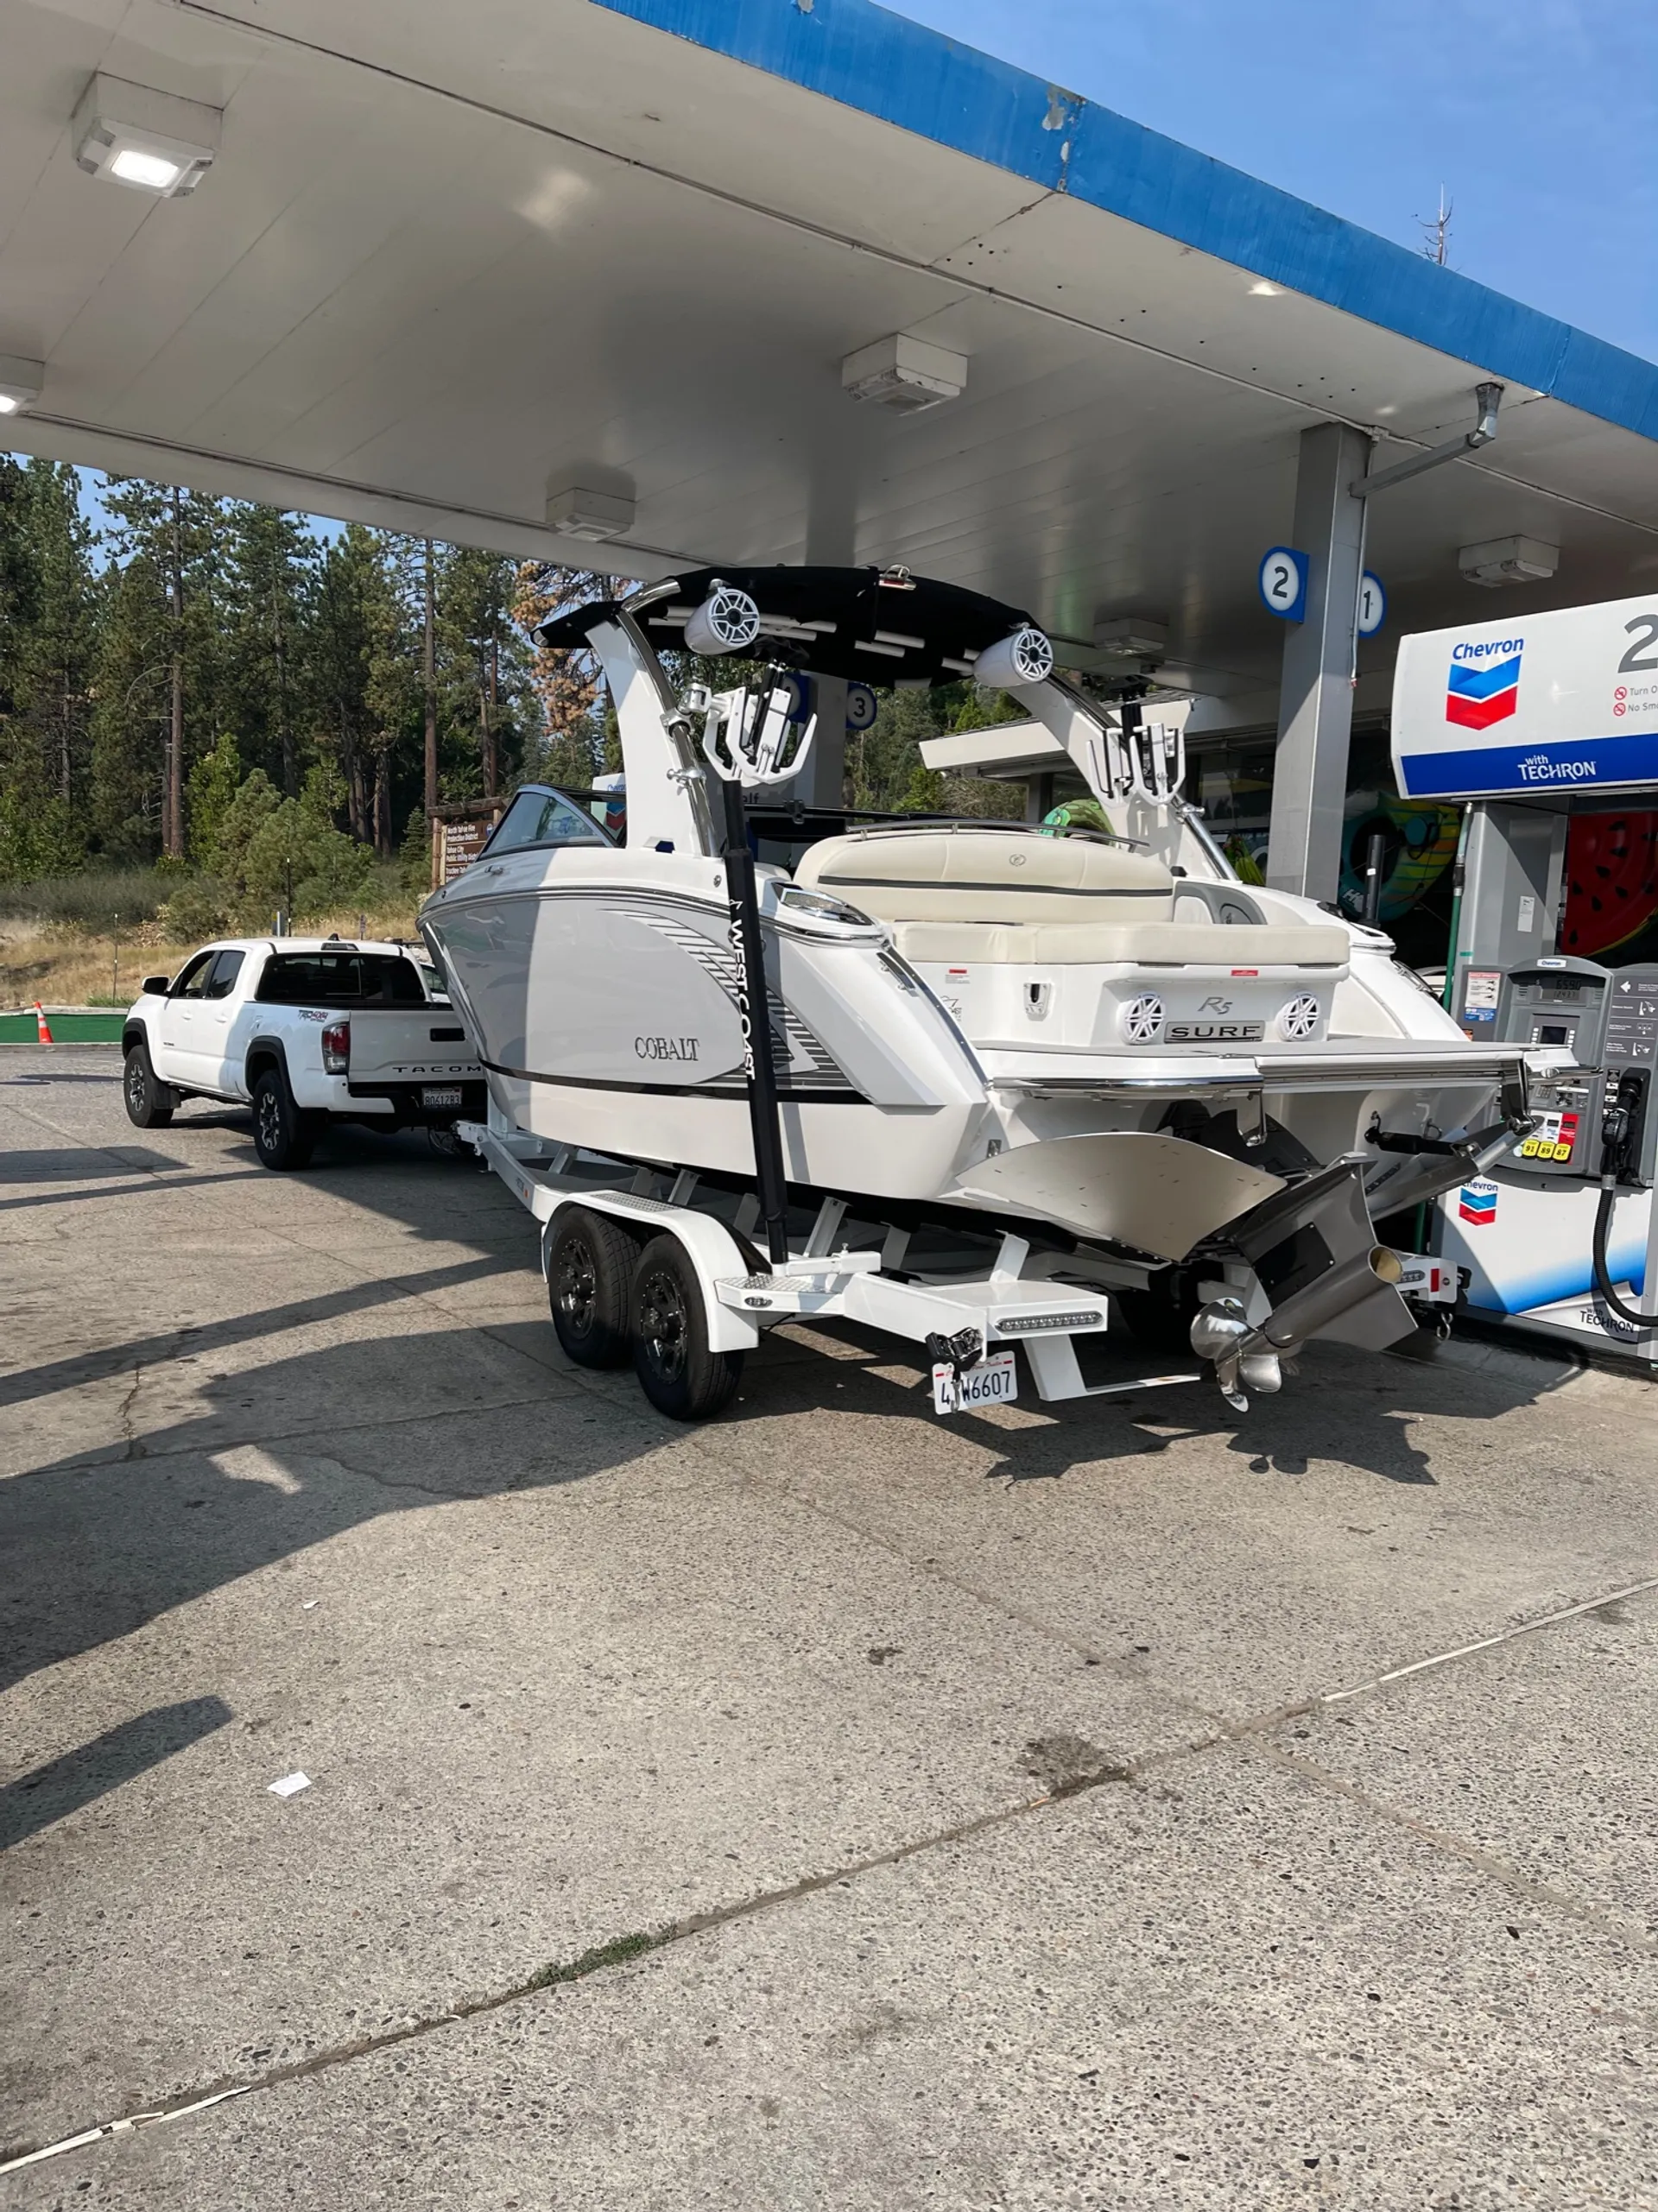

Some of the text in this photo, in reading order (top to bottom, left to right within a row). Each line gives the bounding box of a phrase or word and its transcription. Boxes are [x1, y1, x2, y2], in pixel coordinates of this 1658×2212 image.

[1272, 566, 1288, 598] 2
[1364, 591, 1370, 619] 1
[1452, 638, 1524, 660] Chevron
[1617, 614, 1658, 673] 2
[1630, 687, 1649, 696] Turn
[853, 697, 866, 717] 3
[1525, 755, 1549, 765] with
[1517, 762, 1597, 781] TECHRON
[731, 920, 756, 1080] WEST COAST
[1171, 1026, 1261, 1038] SURF
[635, 1037, 699, 1061] COBALT
[1464, 1181, 1498, 1191] hevron
[1579, 1311, 1634, 1333] TECHRON
[941, 1370, 1010, 1405] 4W6607
